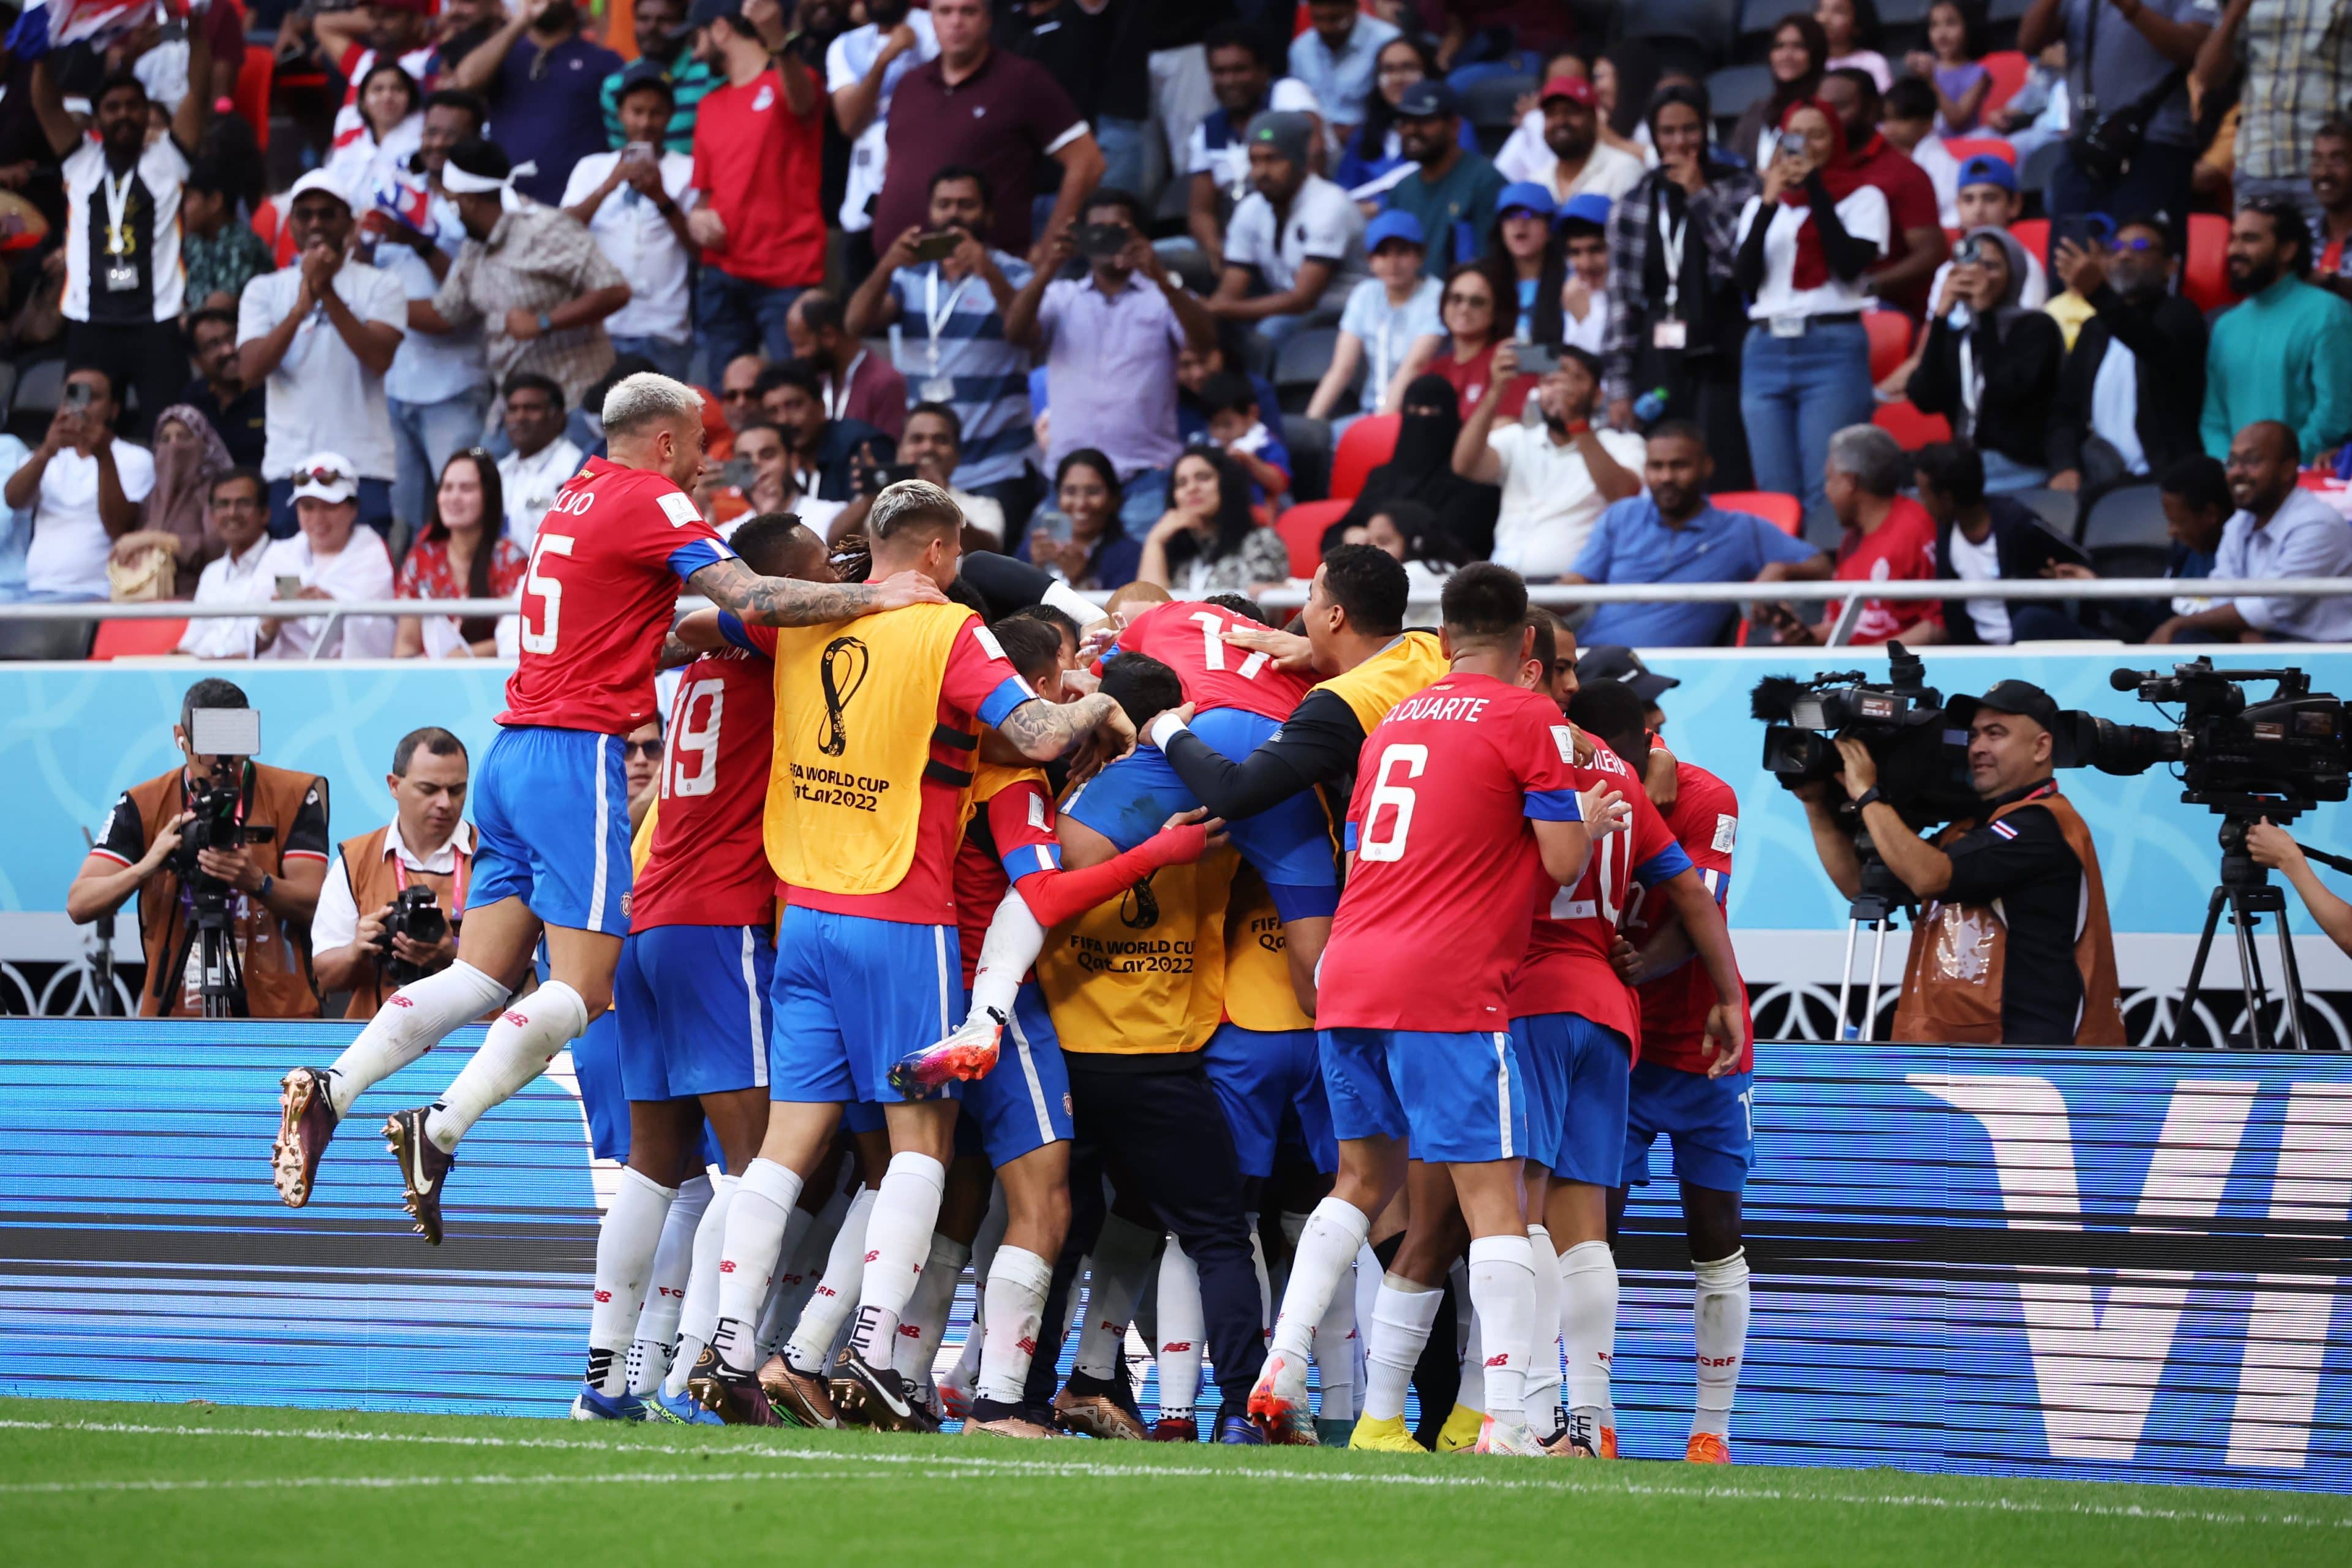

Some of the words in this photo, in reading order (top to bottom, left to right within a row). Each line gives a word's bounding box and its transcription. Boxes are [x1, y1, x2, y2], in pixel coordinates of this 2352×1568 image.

[1189, 611, 1271, 680] 17
[662, 678, 724, 799] 19
[806, 766, 854, 788] WORLD
[858, 776, 889, 793] CUP
[1360, 744, 1428, 862] 6
[1070, 935, 1104, 954] FIFA
[1107, 940, 1170, 955] WORLD
[1174, 940, 1195, 955] CU
[659, 1287, 685, 1298] FC
